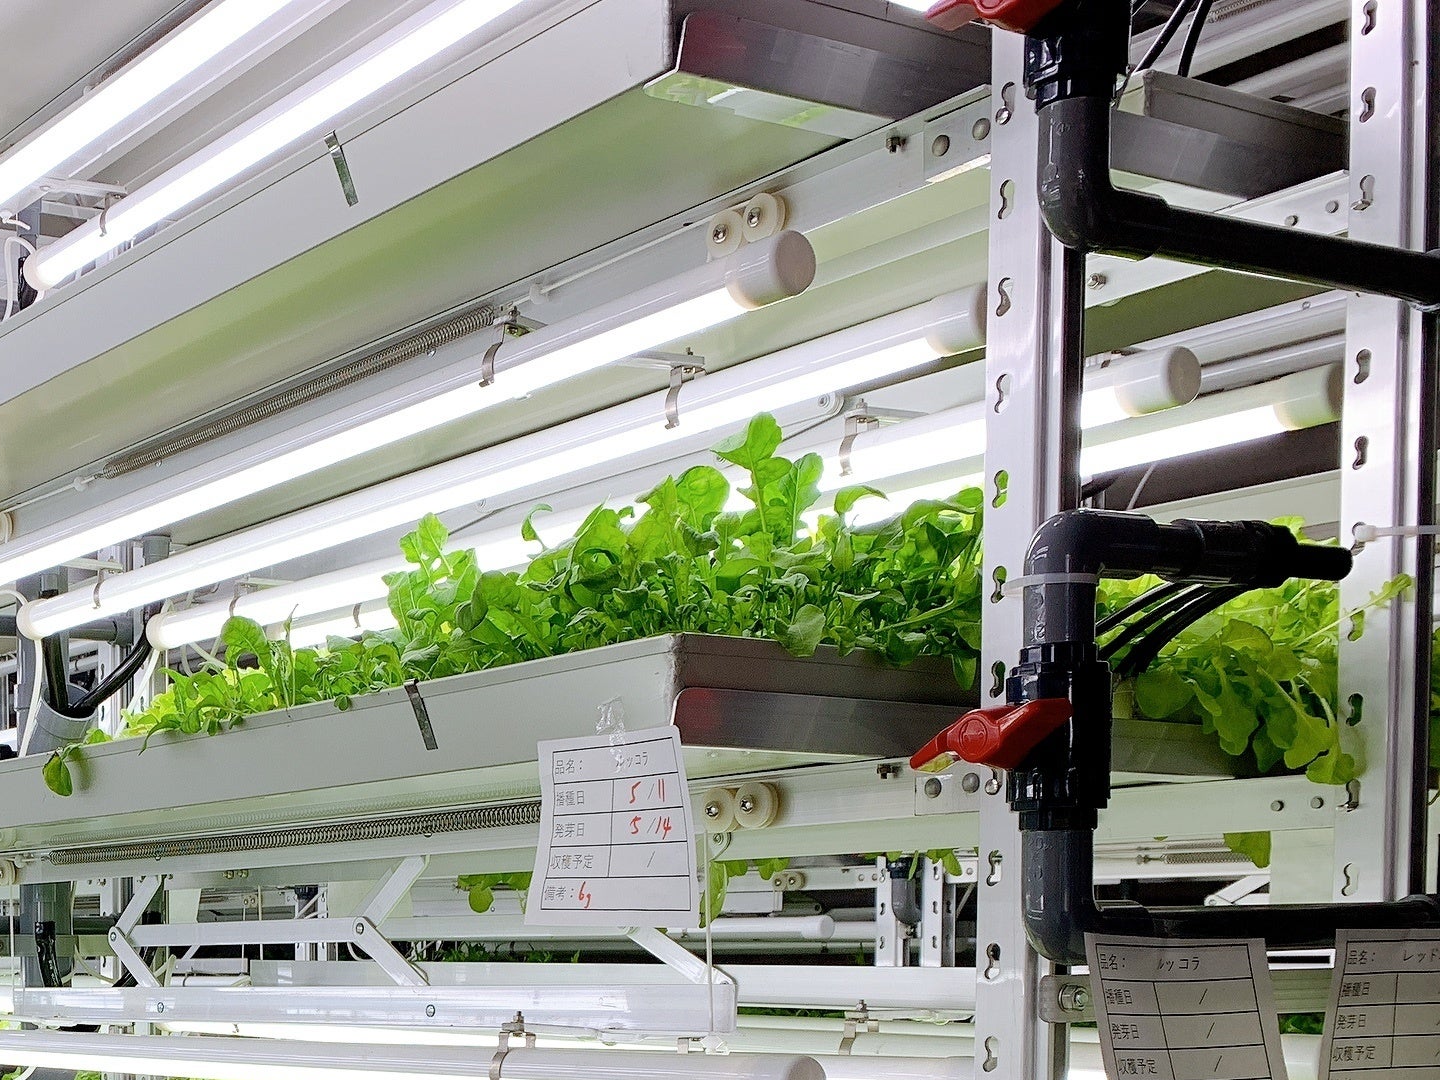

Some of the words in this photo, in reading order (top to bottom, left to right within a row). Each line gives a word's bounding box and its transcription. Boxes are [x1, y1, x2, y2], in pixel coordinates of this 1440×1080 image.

[553, 822, 585, 839] 発芽日
[550, 854, 594, 870] 収穫予定
[1403, 948, 1440, 963] レッド
[1336, 1014, 1366, 1030] 発芽日
[1111, 1023, 1140, 1040] 発芽日
